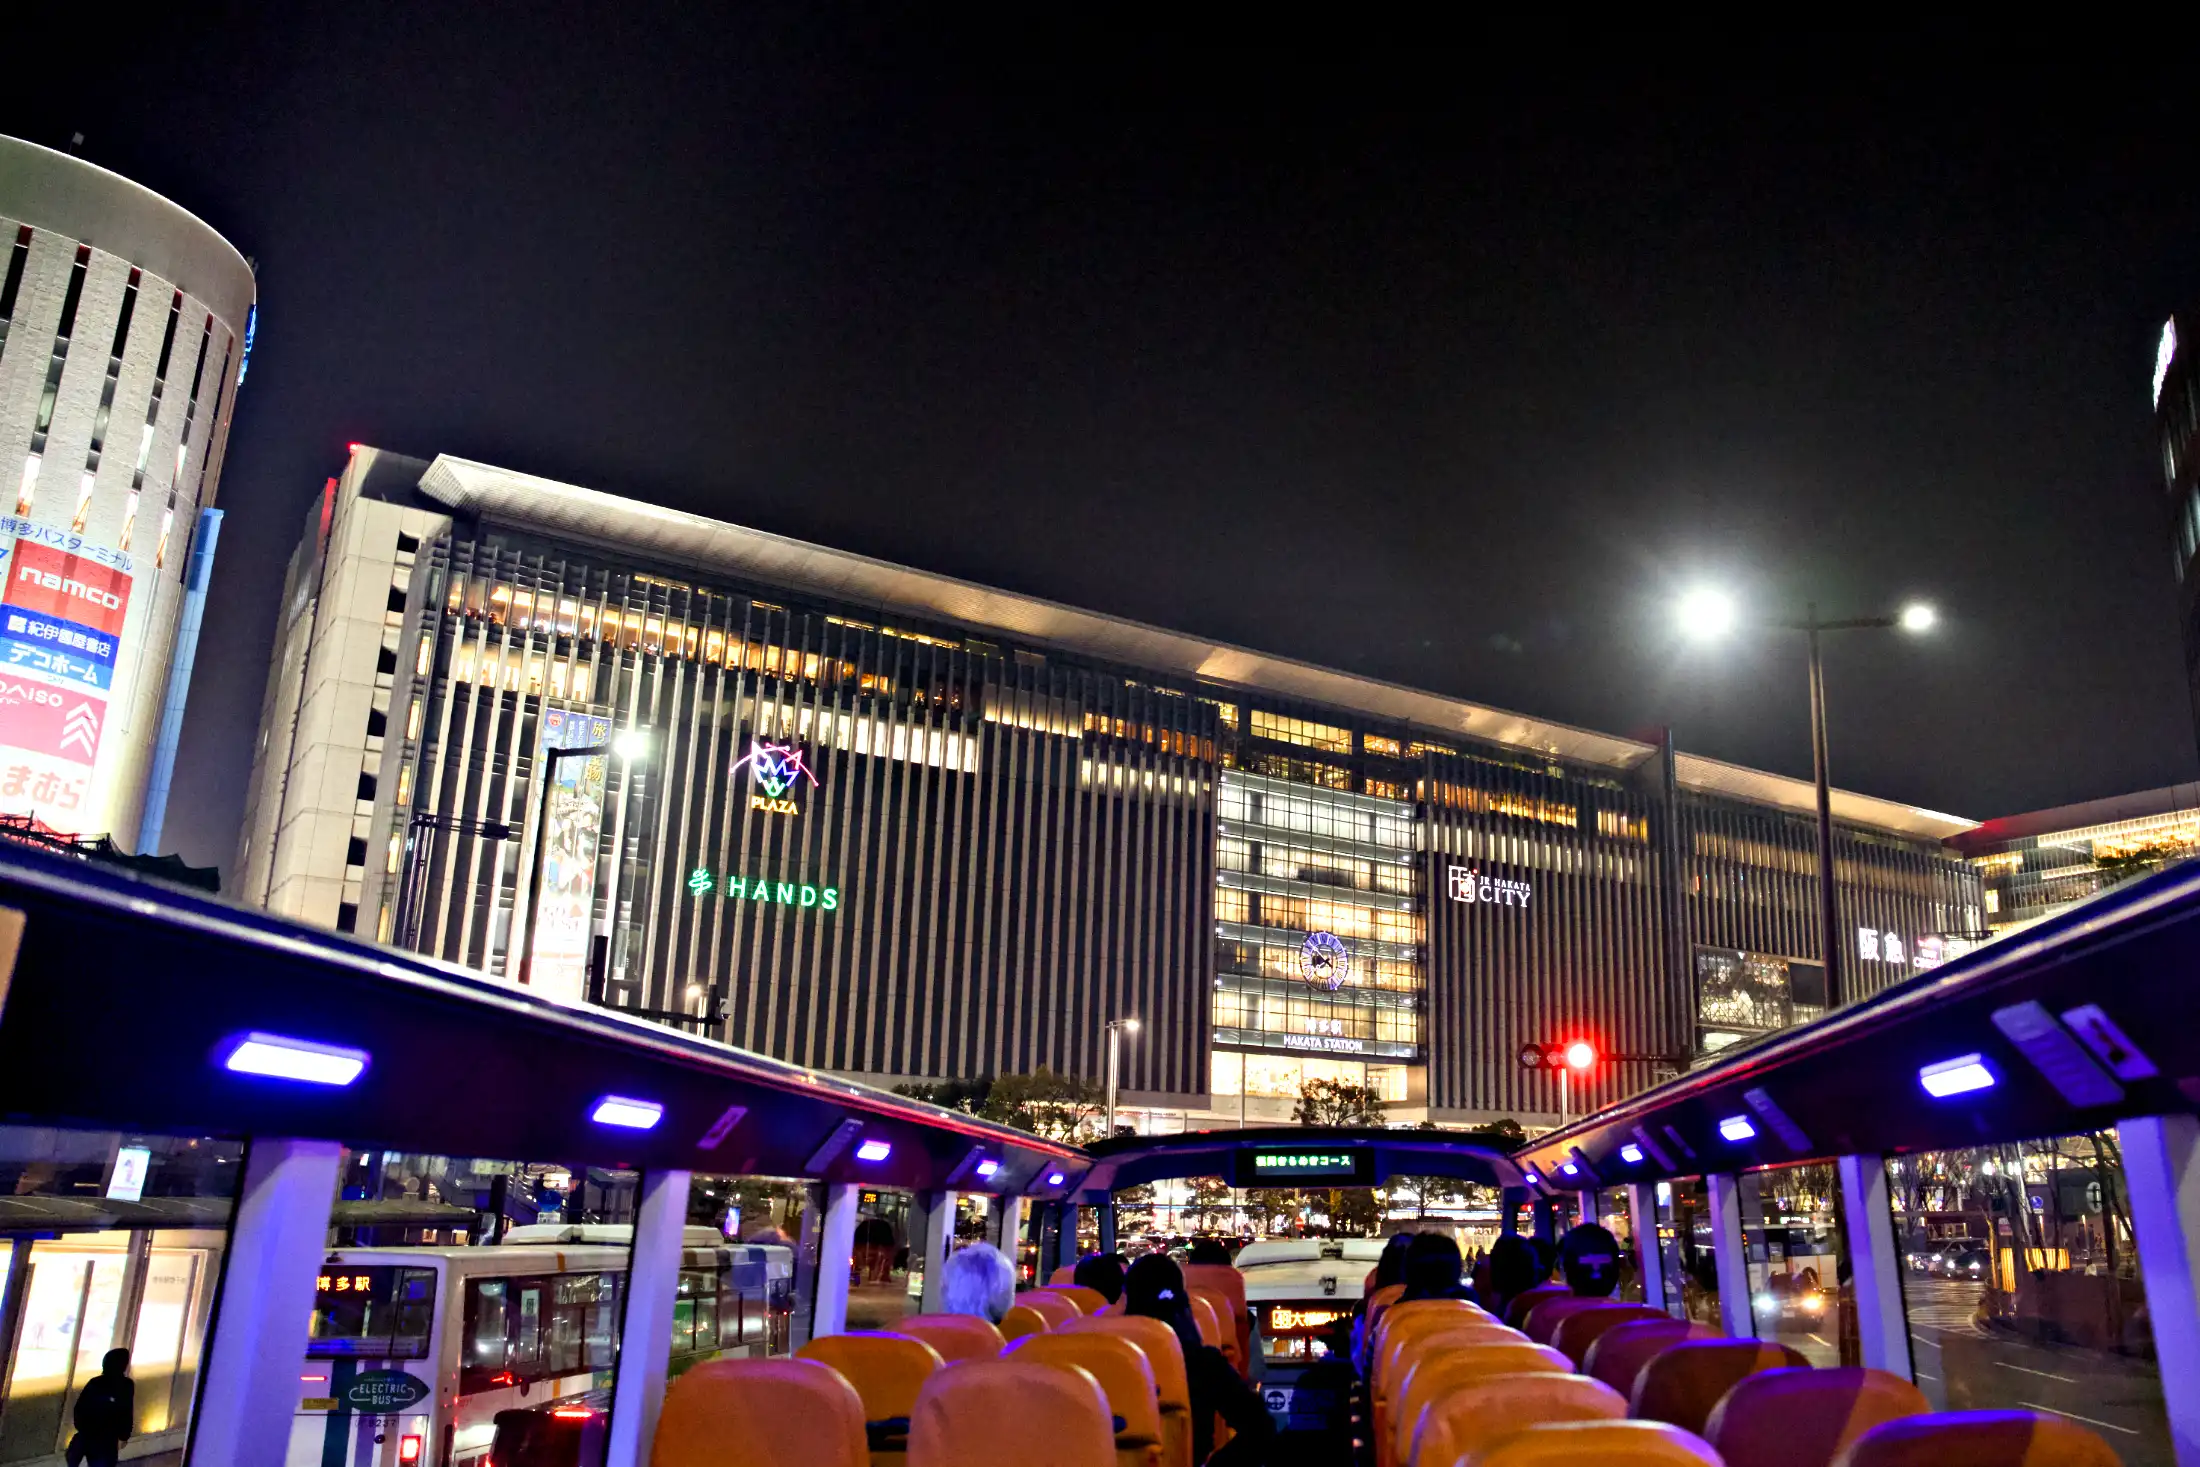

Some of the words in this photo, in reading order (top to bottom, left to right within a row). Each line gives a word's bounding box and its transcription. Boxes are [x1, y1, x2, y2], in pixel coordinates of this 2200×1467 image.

[1, 516, 133, 571] 博多バスターミナル
[20, 566, 119, 610] namco
[9, 642, 98, 685] デコホーム
[2, 765, 84, 811] まむら
[751, 795, 799, 815] PLAZA
[729, 876, 838, 911] HANDS
[1480, 876, 1490, 886] JR
[1494, 878, 1531, 892] HAKATA
[1479, 886, 1531, 907] CITY
[1283, 1034, 1322, 1049] HAKATA
[1324, 1038, 1363, 1051] STATION
[316, 1275, 371, 1292] 博多駅
[359, 1383, 407, 1394] ELECTRIC
[372, 1395, 391, 1405] BUS
